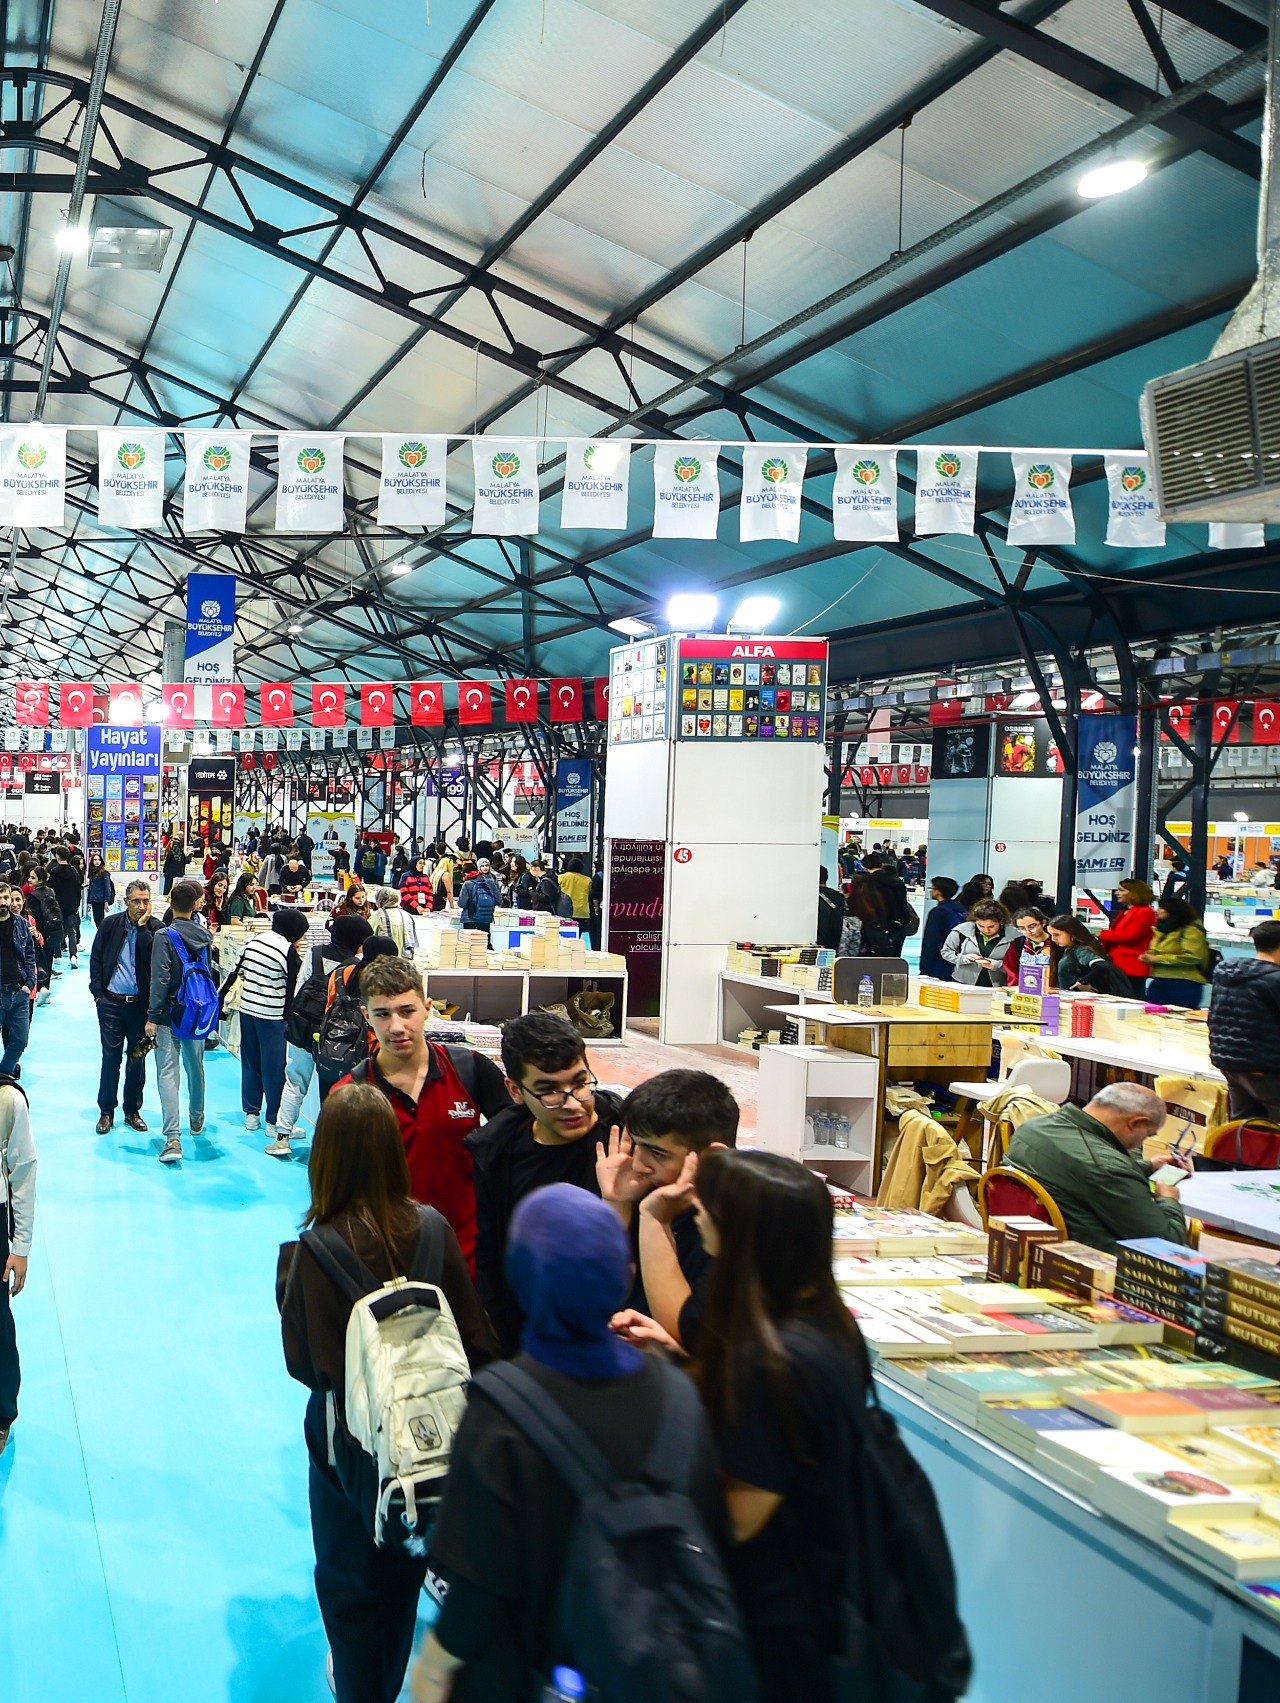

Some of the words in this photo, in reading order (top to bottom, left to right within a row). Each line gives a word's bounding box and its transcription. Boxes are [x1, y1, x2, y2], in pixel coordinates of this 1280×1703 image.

[4, 479, 59, 488] BÜYÜKŞEHİR
[104, 479, 158, 489] BÜYÜKŞEHİR
[384, 478, 440, 487] BÜYÜKŞEHİR
[568, 481, 622, 491] BÜYÜKŞEHİR
[189, 483, 242, 493] BÜYÜKŞEHİR
[282, 485, 338, 494] BÜYÜKŞEHİR
[480, 489, 533, 498] BÜYÜKŞEHİR
[660, 492, 713, 502] BÜYÜKŞEHİR
[188, 623, 232, 631] BÜYÜKŞEHİR
[732, 646, 775, 657] ALFA
[197, 662, 220, 674] HOŞ
[101, 729, 147, 749] Hayat
[90, 750, 158, 771] Yayınları
[1078, 771, 1130, 780] BÜYÜKŞEHİR
[1089, 815, 1115, 828] HOŞ
[1077, 830, 1130, 843] GELDİNİZ
[677, 850, 688, 862] 45
[1077, 859, 1107, 869] SAMİ
[1109, 858, 1125, 867] ER
[611, 865, 650, 874] edebiyat
[1229, 1325, 1280, 1352] NUTUK
